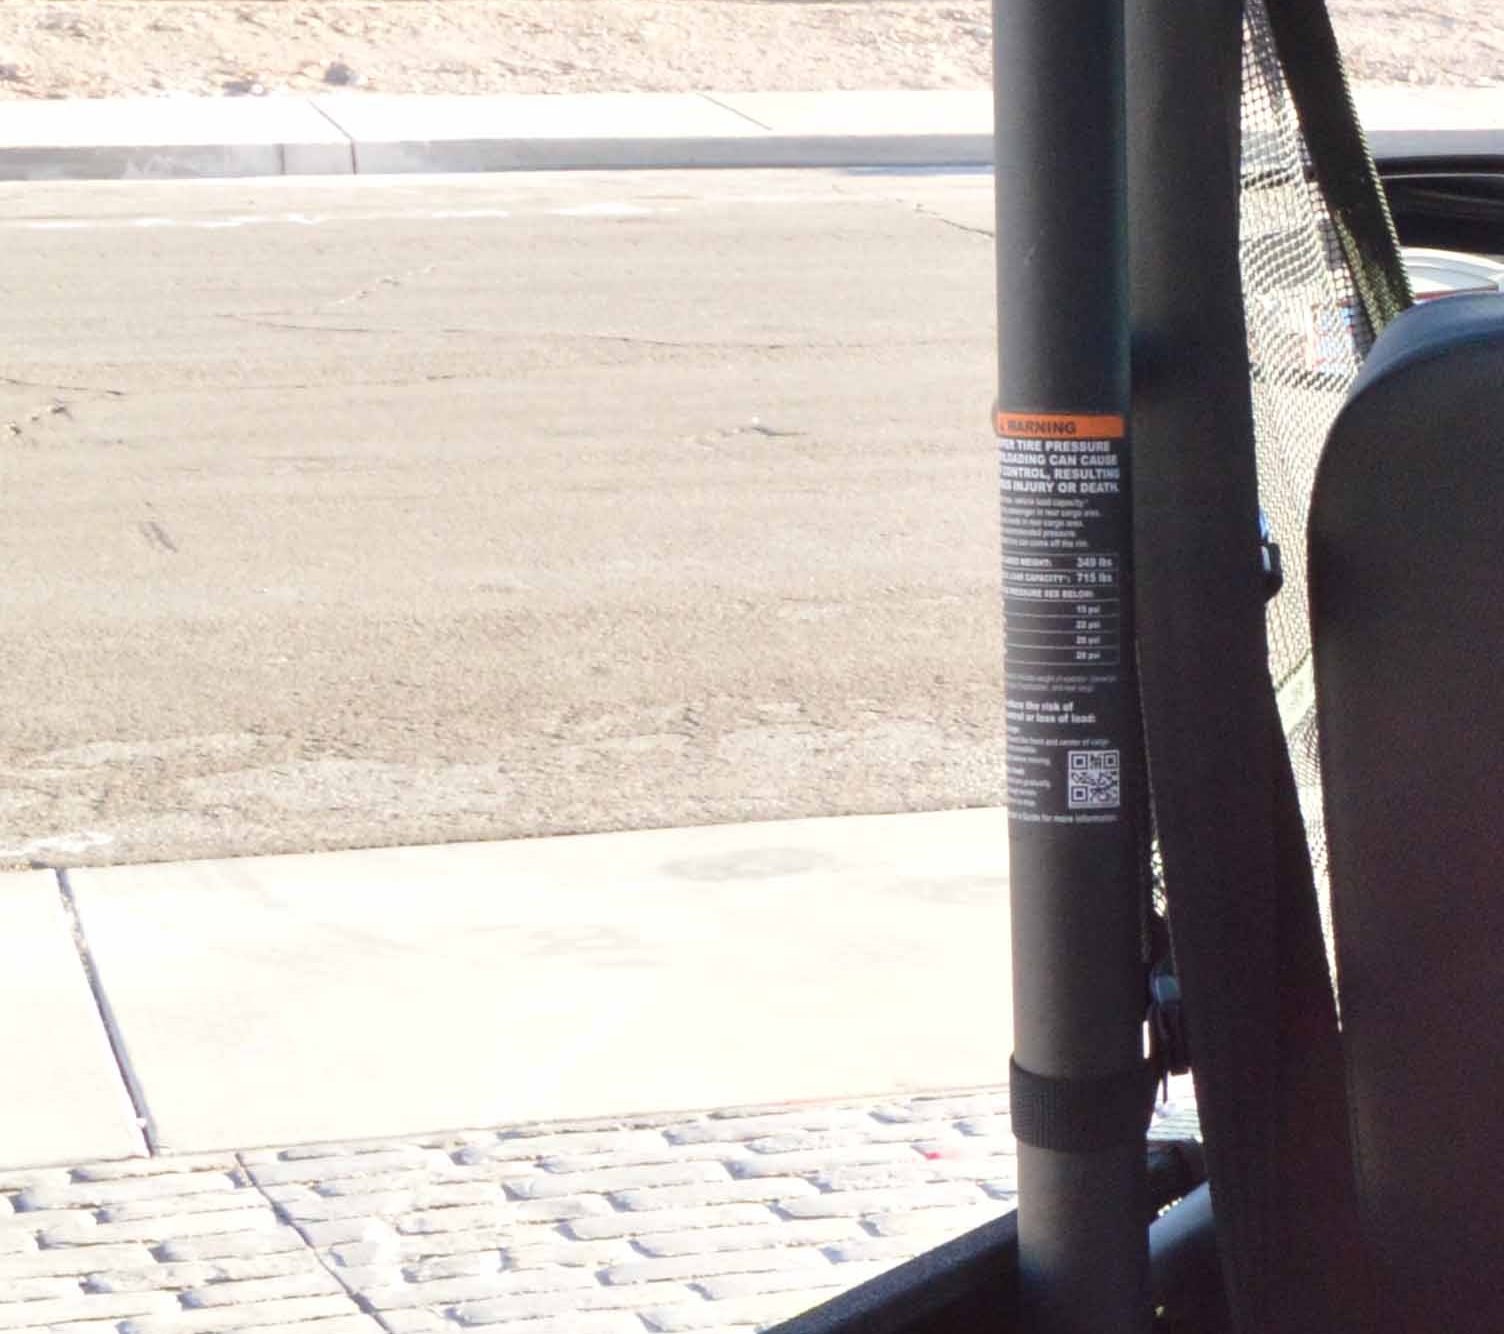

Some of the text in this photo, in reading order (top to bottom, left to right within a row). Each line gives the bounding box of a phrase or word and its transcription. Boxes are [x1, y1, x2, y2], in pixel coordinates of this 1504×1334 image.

[1017, 440, 1042, 452] TIRE
[1045, 441, 1110, 452] PRESSURE
[1049, 454, 1077, 466] CAN
[1080, 454, 1118, 466] CAUSE
[1054, 467, 1121, 479] RESULTING
[1013, 481, 1055, 493] INJURY
[1057, 482, 1077, 493] OR
